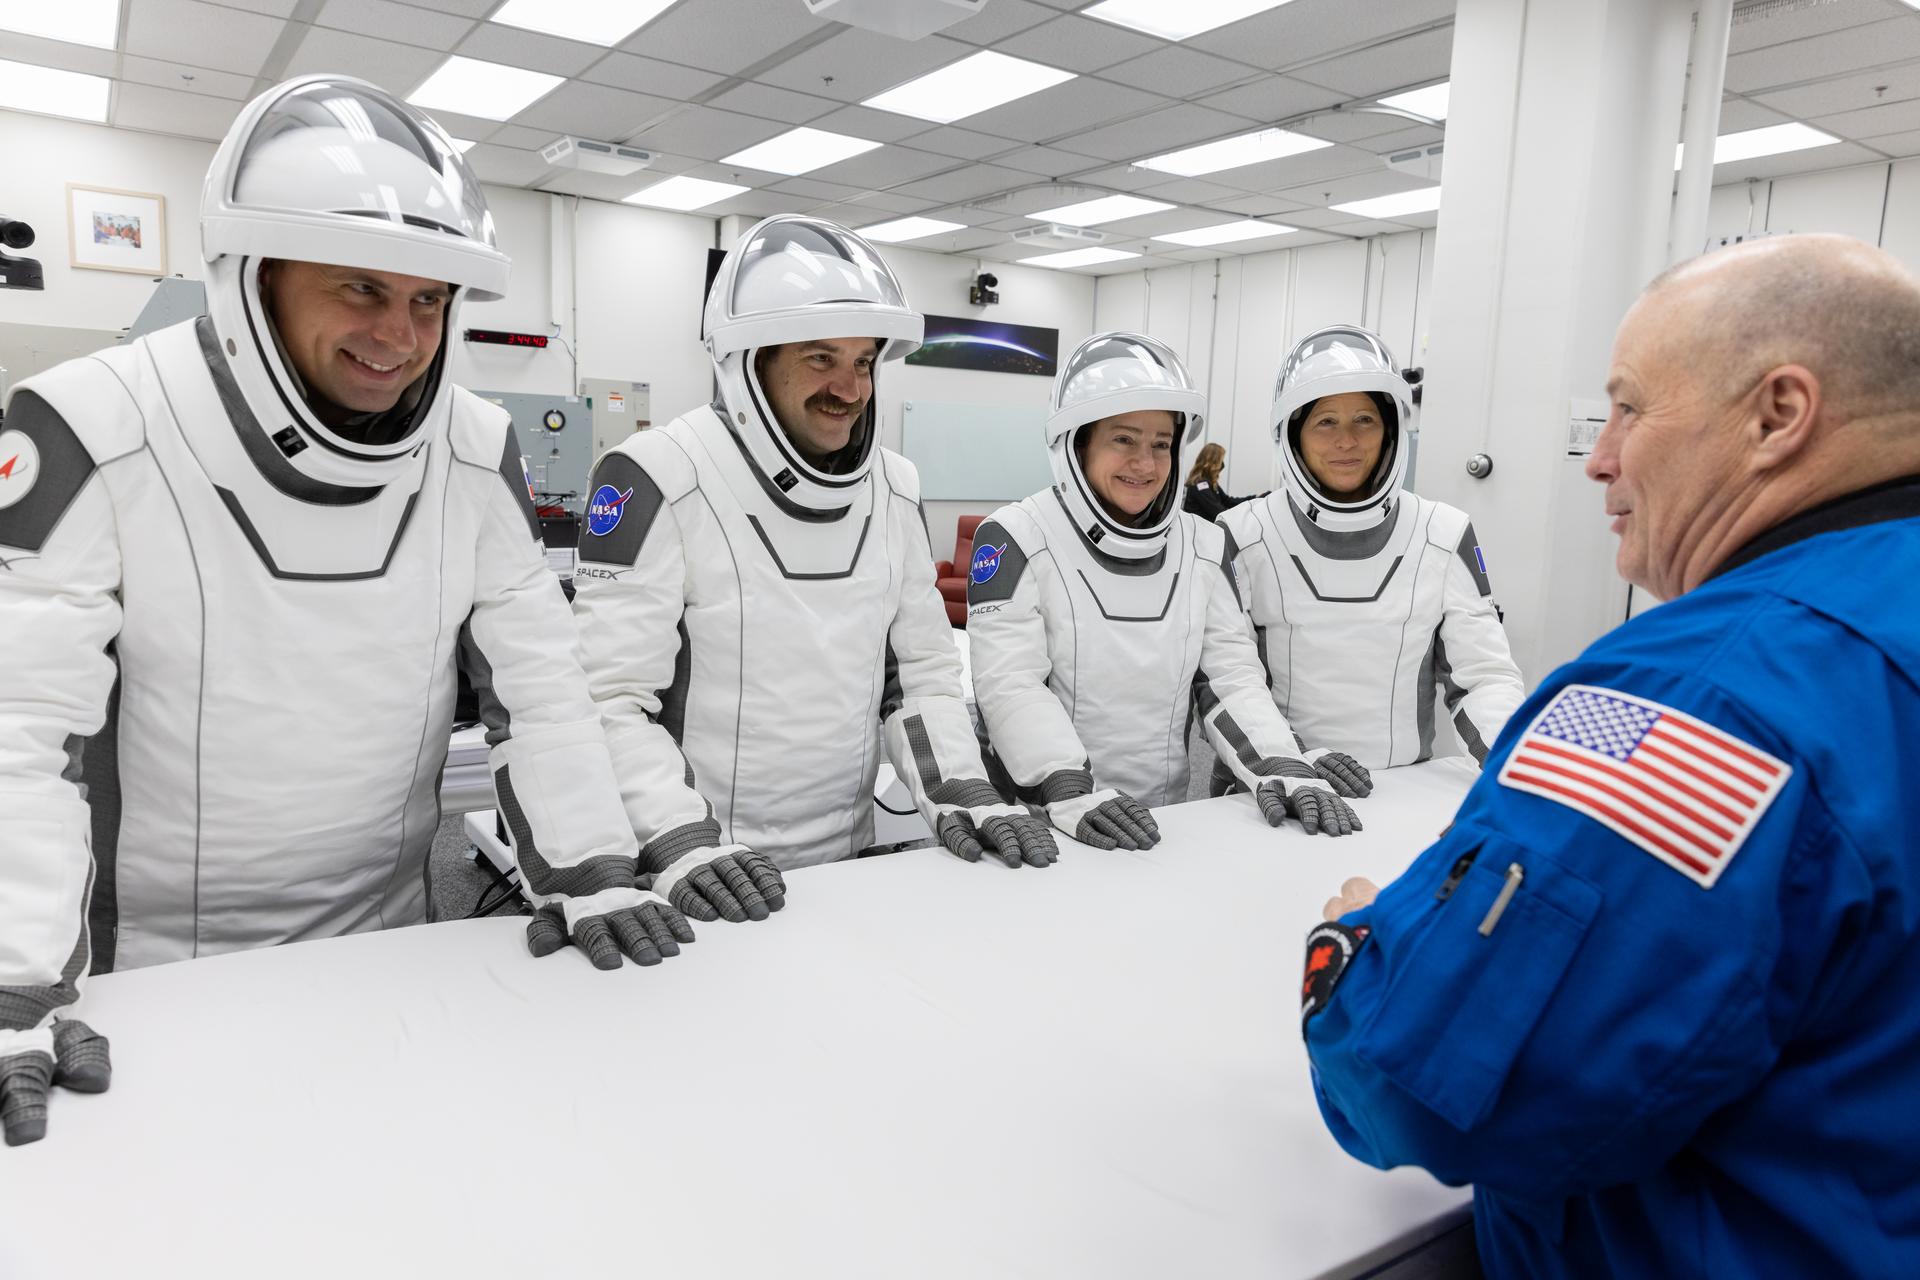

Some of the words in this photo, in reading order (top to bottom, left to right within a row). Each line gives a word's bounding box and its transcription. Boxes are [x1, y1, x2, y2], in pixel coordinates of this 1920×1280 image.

[592, 504, 618, 516] NASA
[974, 559, 996, 569] NASA
[577, 568, 634, 581] SPACEX
